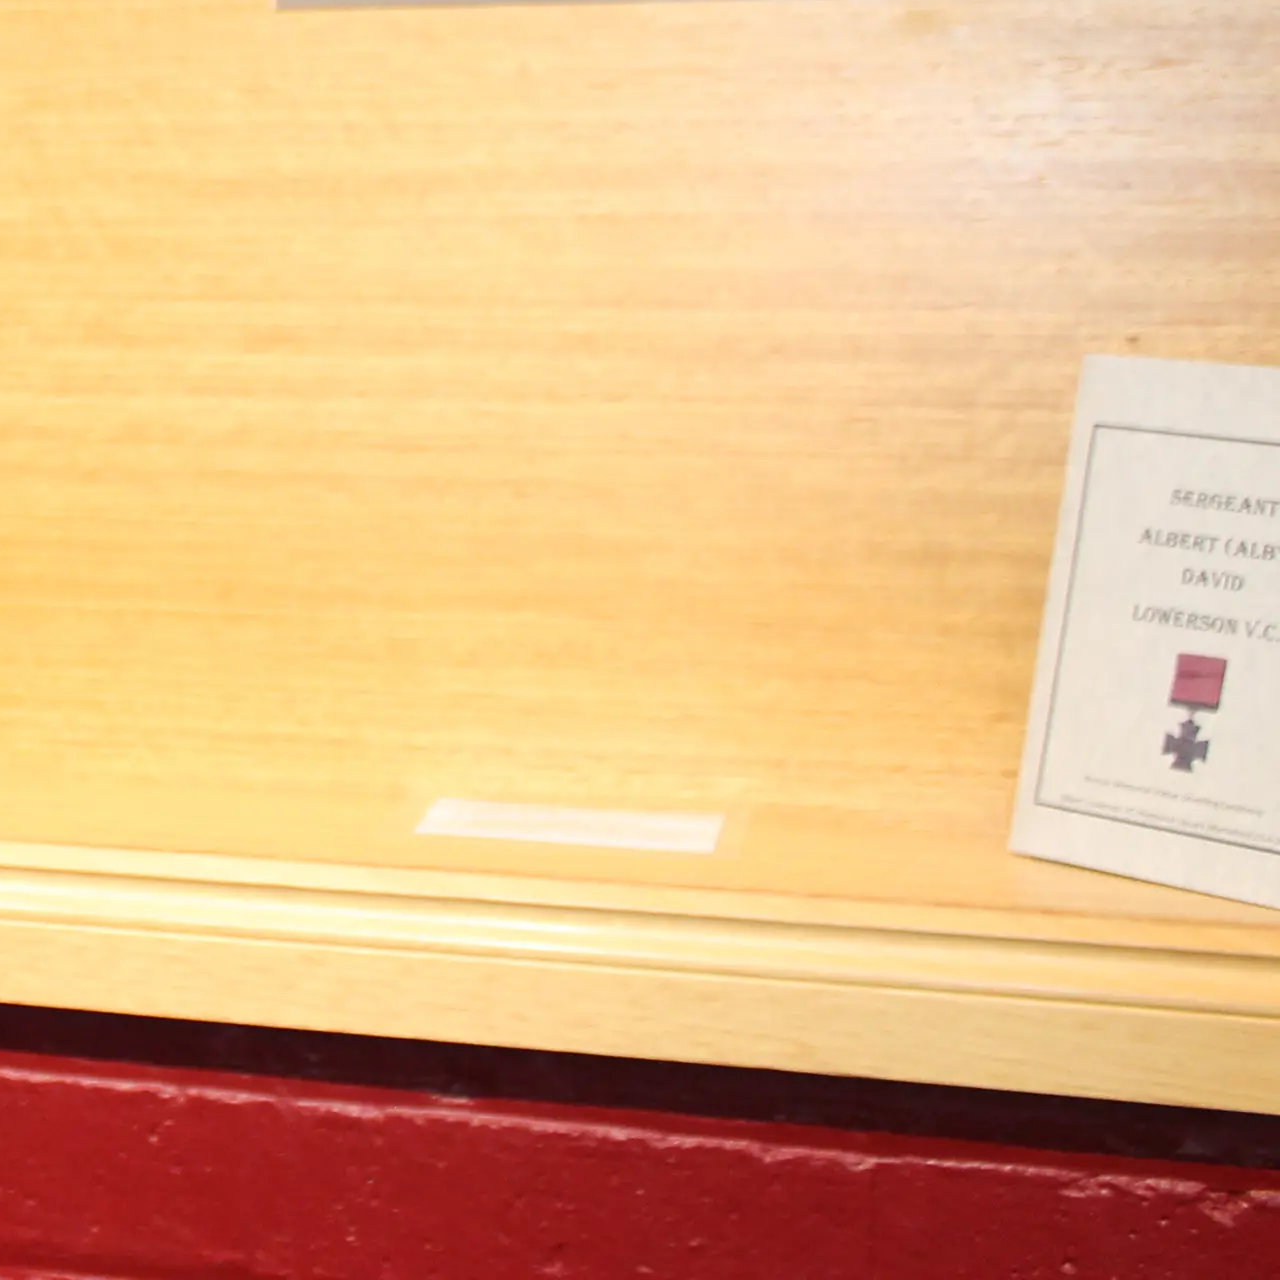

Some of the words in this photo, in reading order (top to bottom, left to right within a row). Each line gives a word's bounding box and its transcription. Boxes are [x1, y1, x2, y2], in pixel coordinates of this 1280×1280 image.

[1169, 488, 1280, 518] SERGEANT
[1137, 526, 1220, 554] ALBERT
[1181, 568, 1246, 593] DAVID
[1132, 604, 1239, 635] LOWERSON
